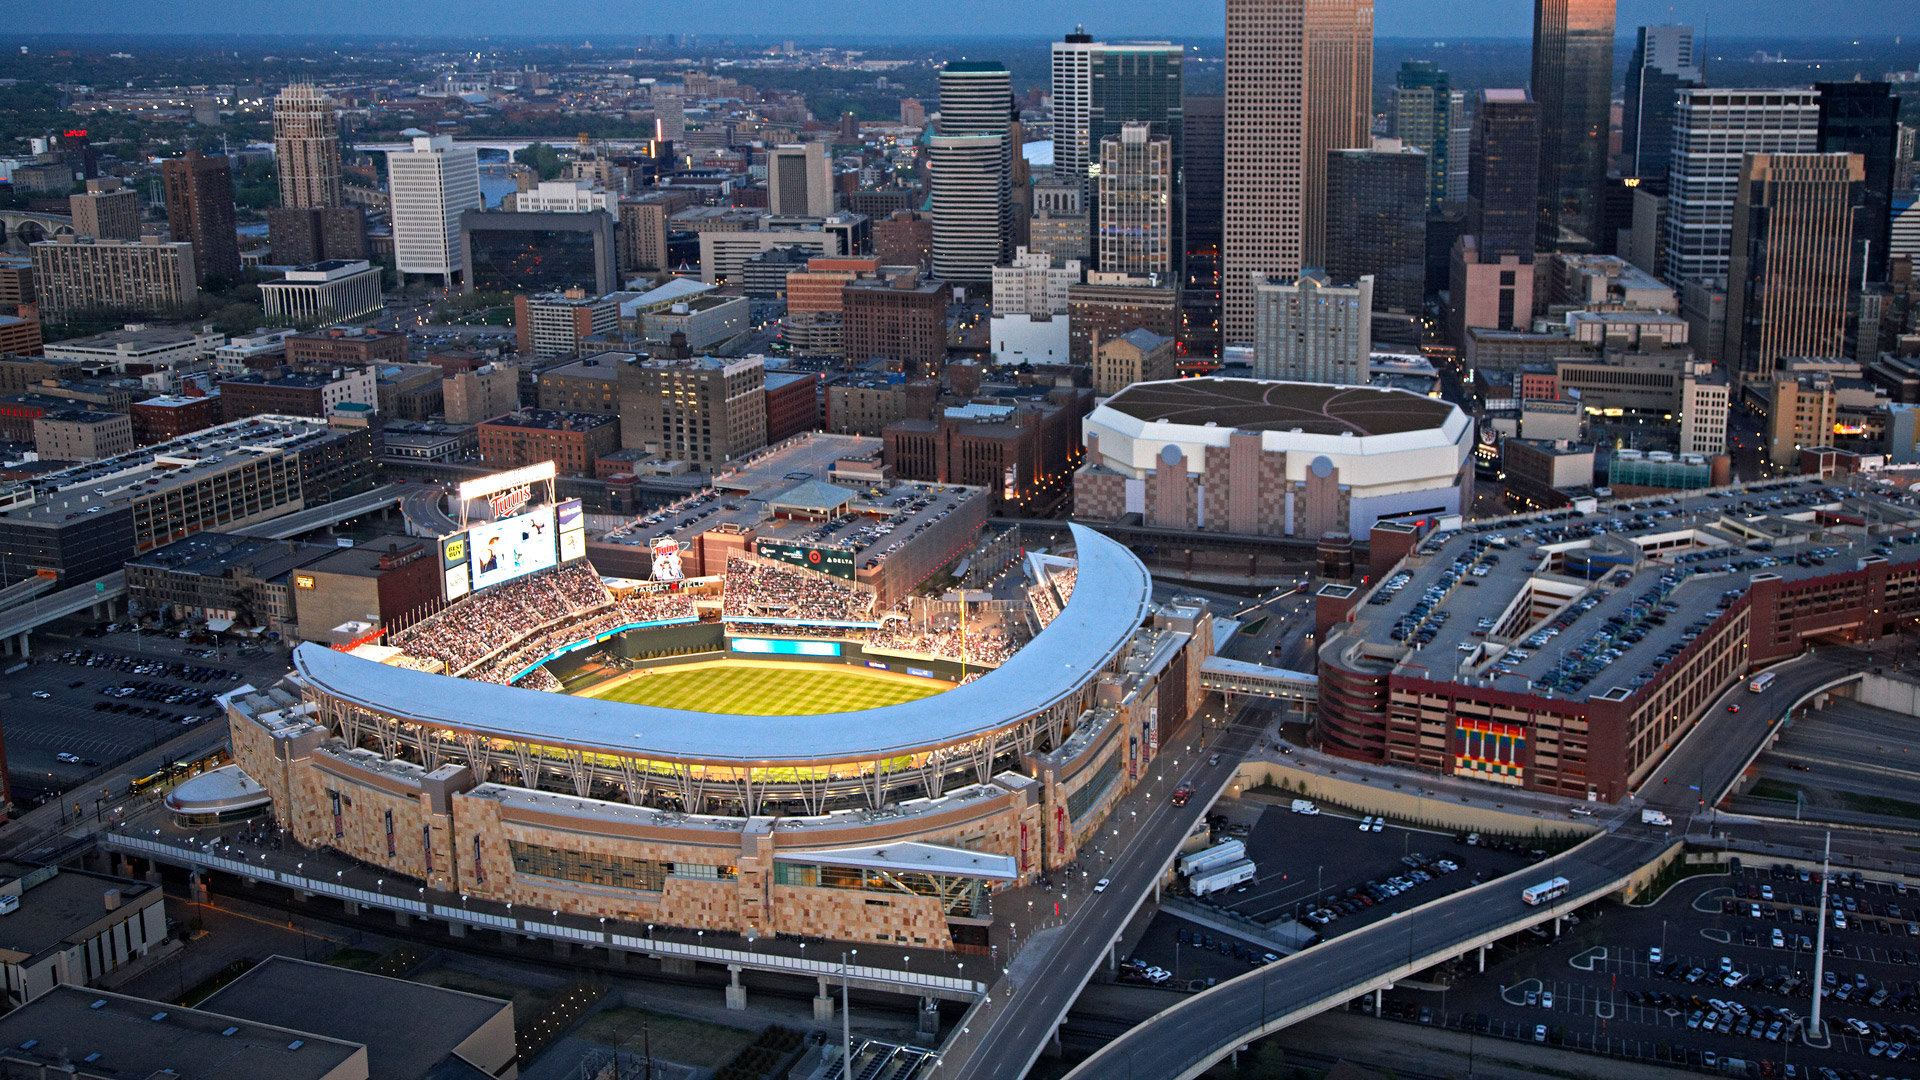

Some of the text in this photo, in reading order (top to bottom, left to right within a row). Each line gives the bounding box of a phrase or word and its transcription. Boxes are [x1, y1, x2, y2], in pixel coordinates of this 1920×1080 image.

[489, 487, 531, 518] Twins
[448, 544, 462, 552] BEST
[653, 544, 678, 556] Twins
[633, 581, 705, 593] TARGET FIELD
